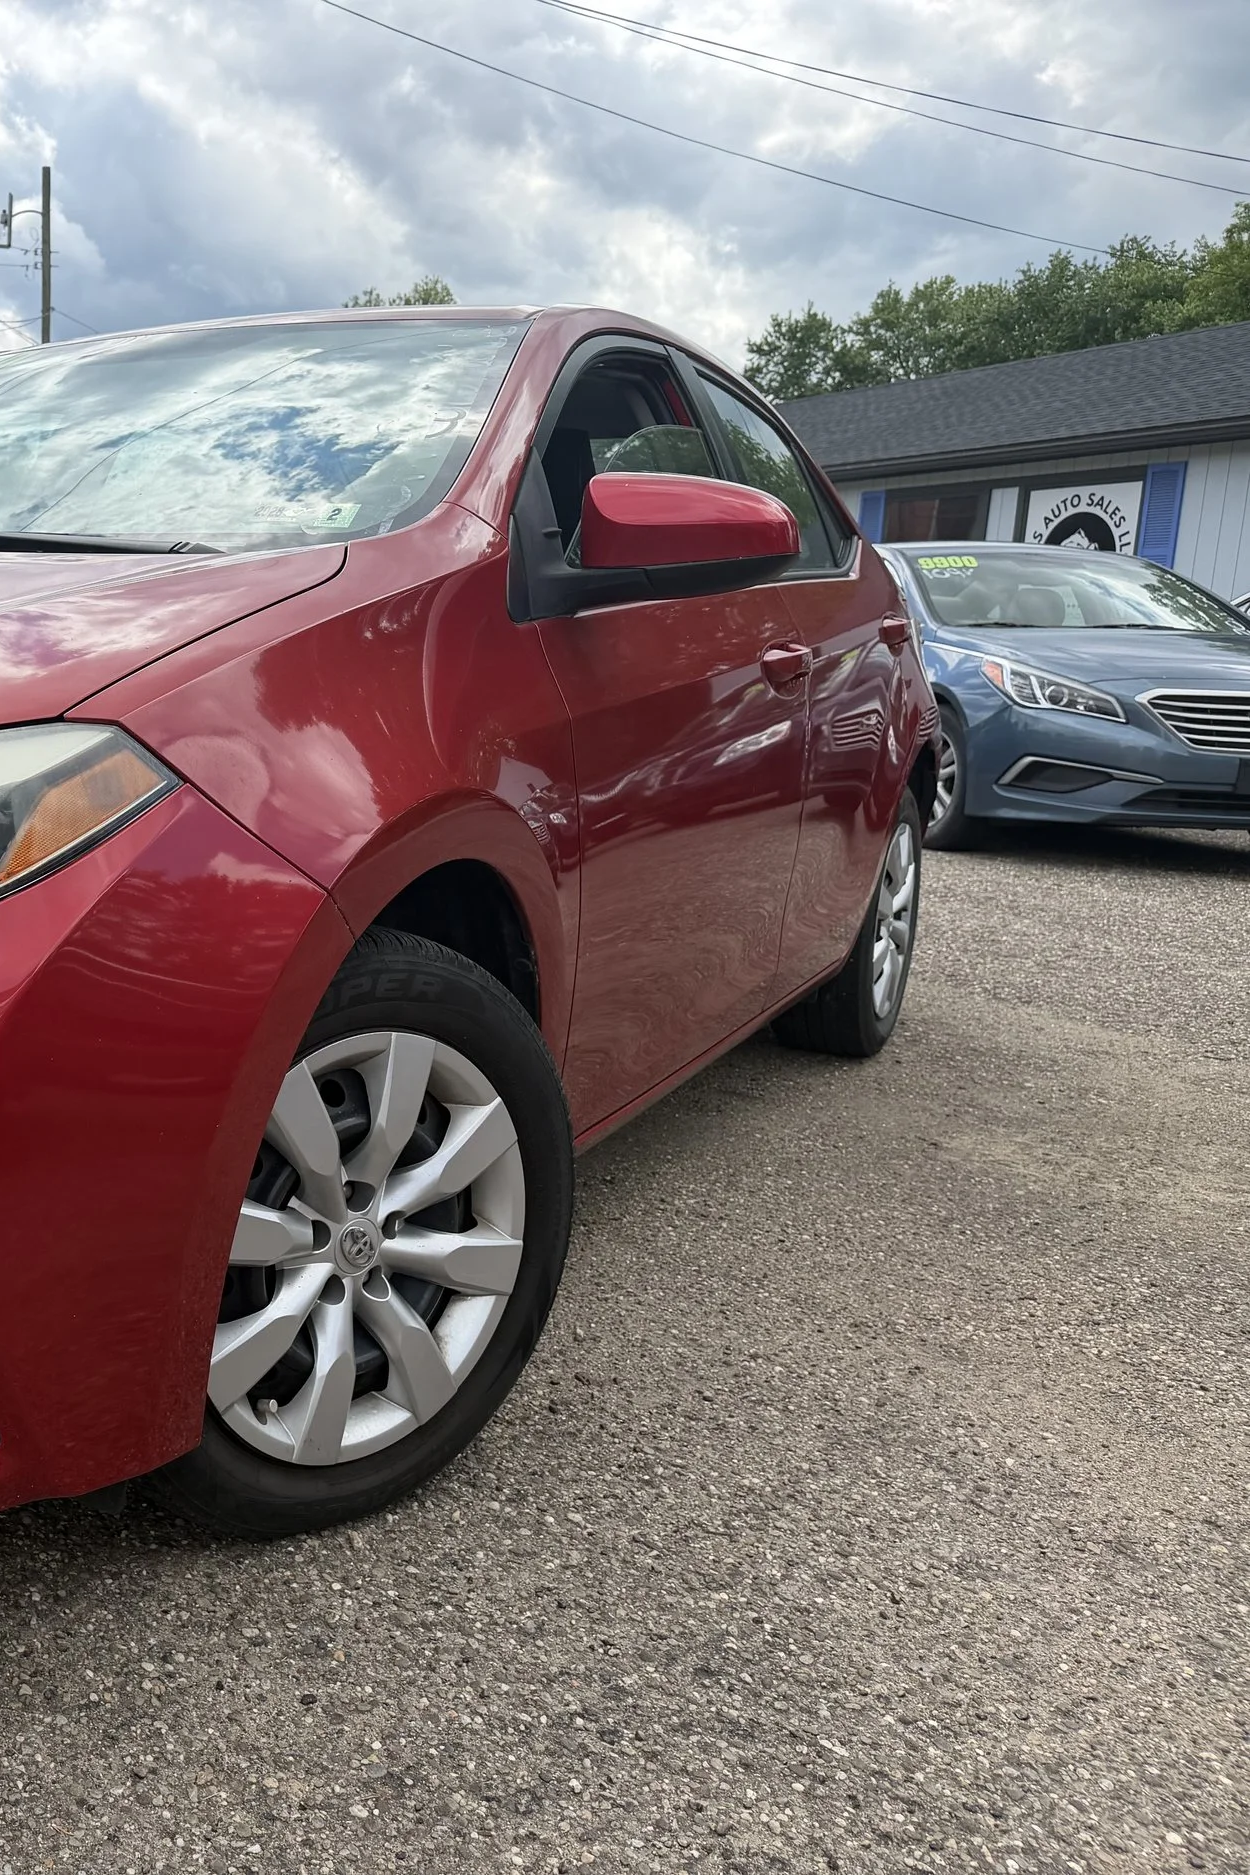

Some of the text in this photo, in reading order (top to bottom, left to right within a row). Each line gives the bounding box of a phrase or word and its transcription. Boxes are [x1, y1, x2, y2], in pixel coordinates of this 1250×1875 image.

[327, 508, 342, 521] 2
[1043, 494, 1081, 529] AUTO
[1086, 493, 1126, 528] SALES
[1118, 531, 1131, 555] LL
[918, 556, 978, 569] 9900
